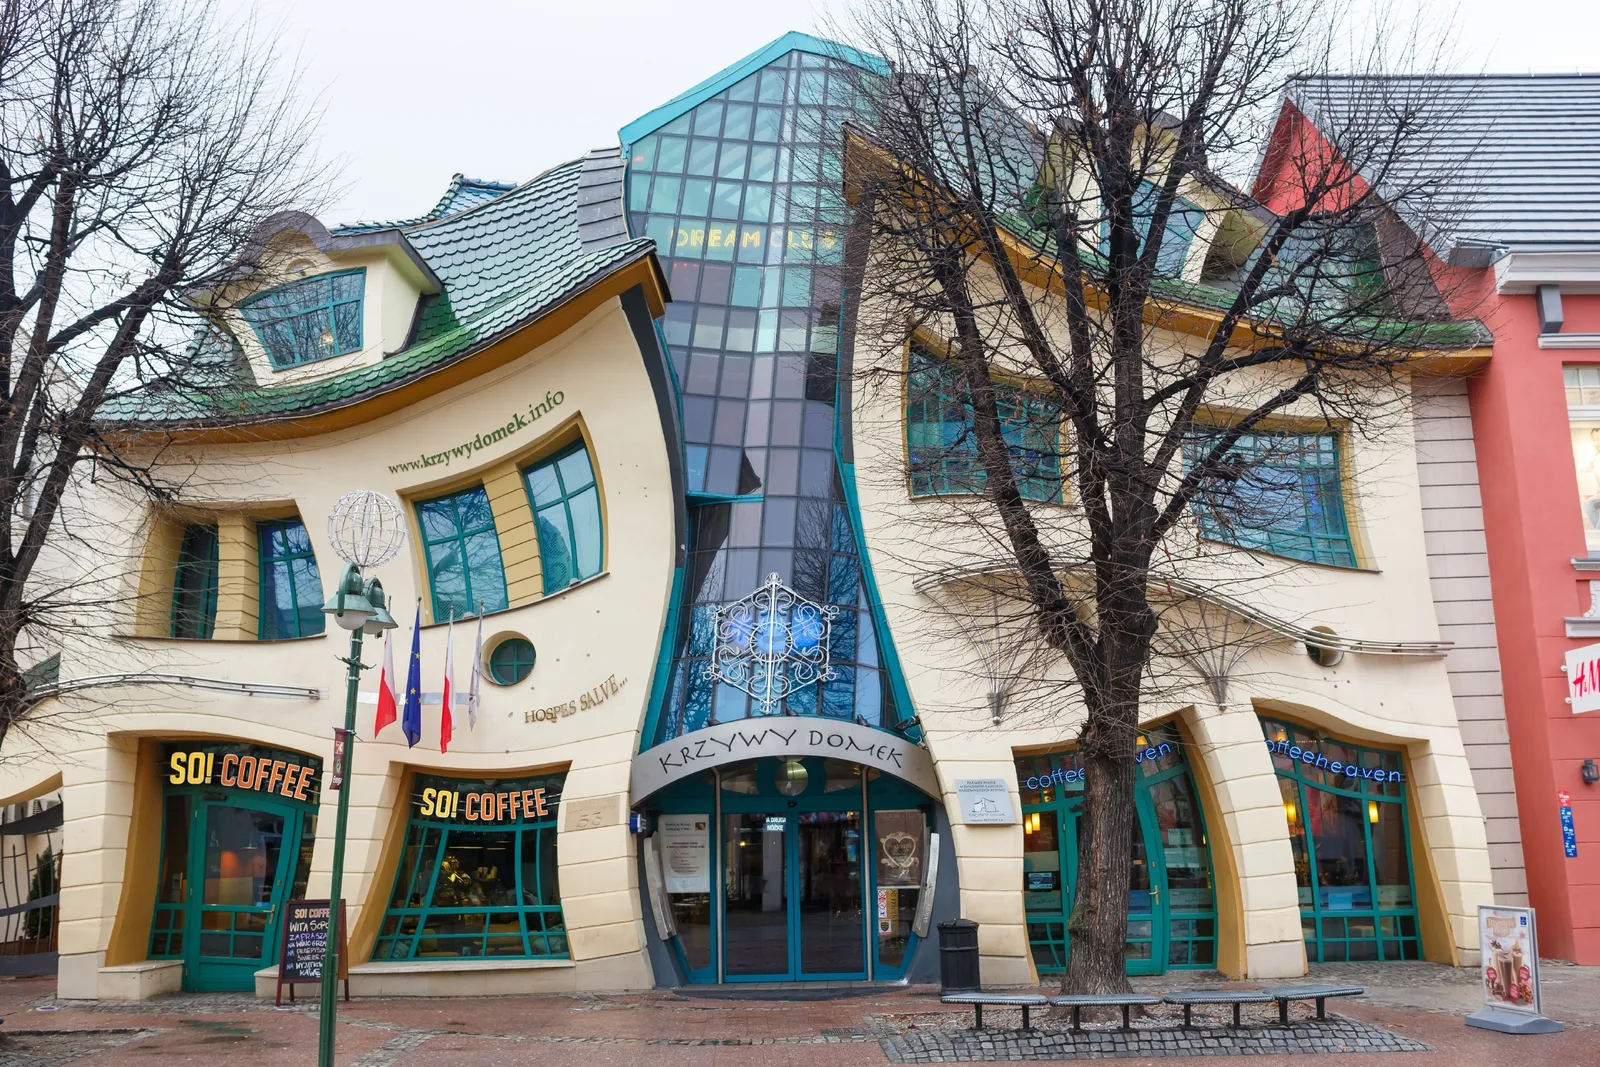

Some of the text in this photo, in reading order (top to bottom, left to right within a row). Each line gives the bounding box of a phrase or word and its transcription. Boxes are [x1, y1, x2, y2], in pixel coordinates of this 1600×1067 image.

[670, 228, 760, 248] DREAM
[388, 390, 565, 475] www.krzywydomek.info
[524, 699, 577, 724] HOSPES
[659, 728, 903, 774] KRZYWY DOMEK
[1264, 739, 1401, 783] offeeheaven
[169, 751, 315, 801] SO! COFFEE
[420, 787, 549, 821] SO! COFFEE
[577, 811, 603, 828] 53
[294, 908, 330, 918] SO! COFFE
[289, 922, 309, 932] WITA
[290, 932, 328, 941] ZAPRASZA
